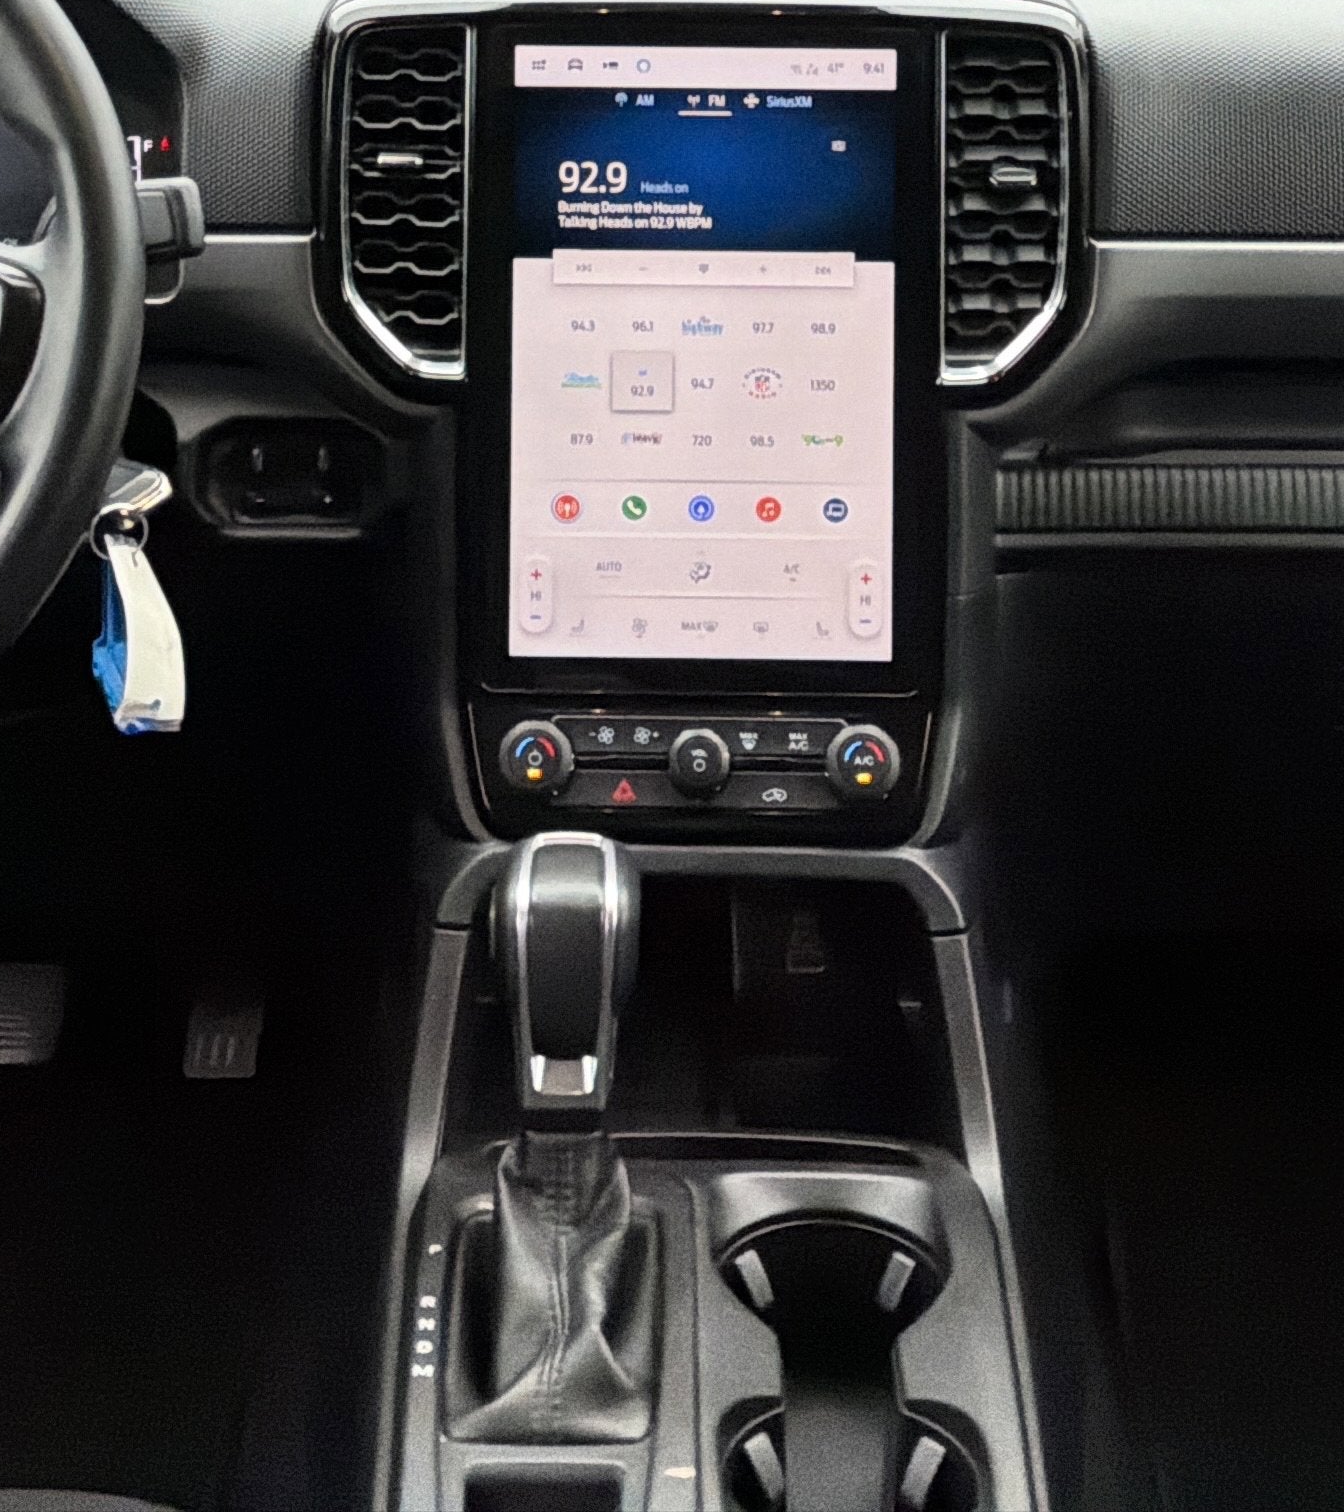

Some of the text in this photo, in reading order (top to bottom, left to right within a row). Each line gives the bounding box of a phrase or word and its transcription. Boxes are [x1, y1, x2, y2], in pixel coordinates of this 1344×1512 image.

[635, 94, 655, 107] AM
[708, 95, 726, 107] FM
[766, 95, 813, 108] SiriusXM
[143, 139, 154, 153] F
[558, 160, 628, 194] 92.9
[640, 181, 689, 194] Heads on
[558, 199, 703, 216] Burning Down the House by
[558, 215, 598, 230] Talking
[598, 216, 633, 229] Heads
[634, 218, 649, 229] on
[650, 216, 675, 229] 92.9
[571, 319, 596, 332] 94.3
[631, 320, 654, 332] 96.1
[752, 322, 774, 334] 97.7
[810, 323, 837, 335] 98.9
[630, 385, 655, 397] 92.9
[692, 434, 713, 447] 720
[595, 561, 623, 572] AUTO
[783, 563, 800, 575] A/C
[681, 621, 702, 631] MAX
[788, 732, 808, 740] MAX
[788, 740, 809, 751] A/C
[853, 755, 875, 766] A/C
[417, 1317, 436, 1331] N
[415, 1339, 434, 1354] D
[412, 1363, 435, 1378] M
